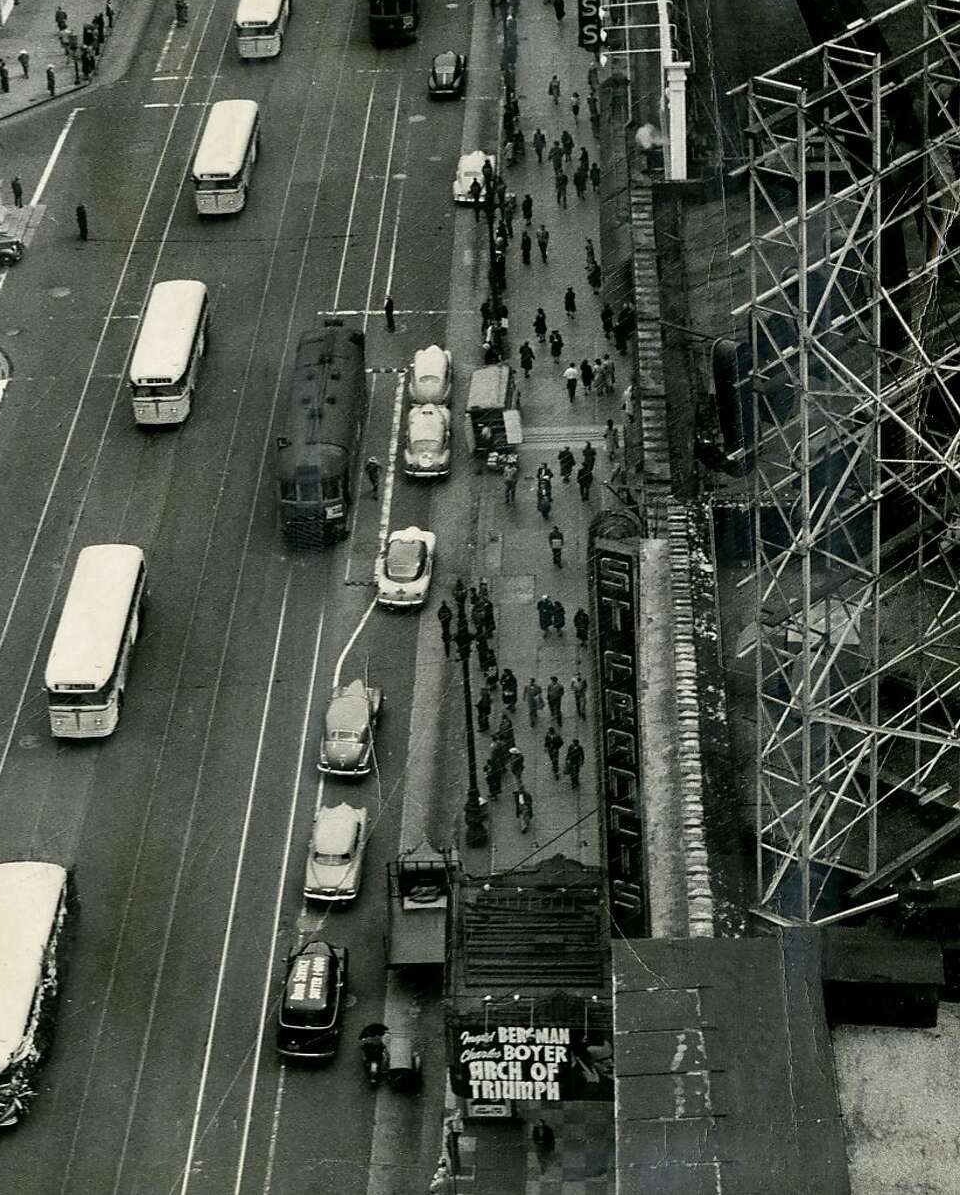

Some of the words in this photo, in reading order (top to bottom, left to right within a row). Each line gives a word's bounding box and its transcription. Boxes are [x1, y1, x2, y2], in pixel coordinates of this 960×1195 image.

[498, 1027, 570, 1045] BERGMAN
[460, 1048, 501, 1063] Charles
[504, 1046, 568, 1063] BOYER
[469, 1061, 522, 1081] ARCH
[530, 1063, 559, 1082] OF
[469, 1081, 560, 1101] TRIUMPH
